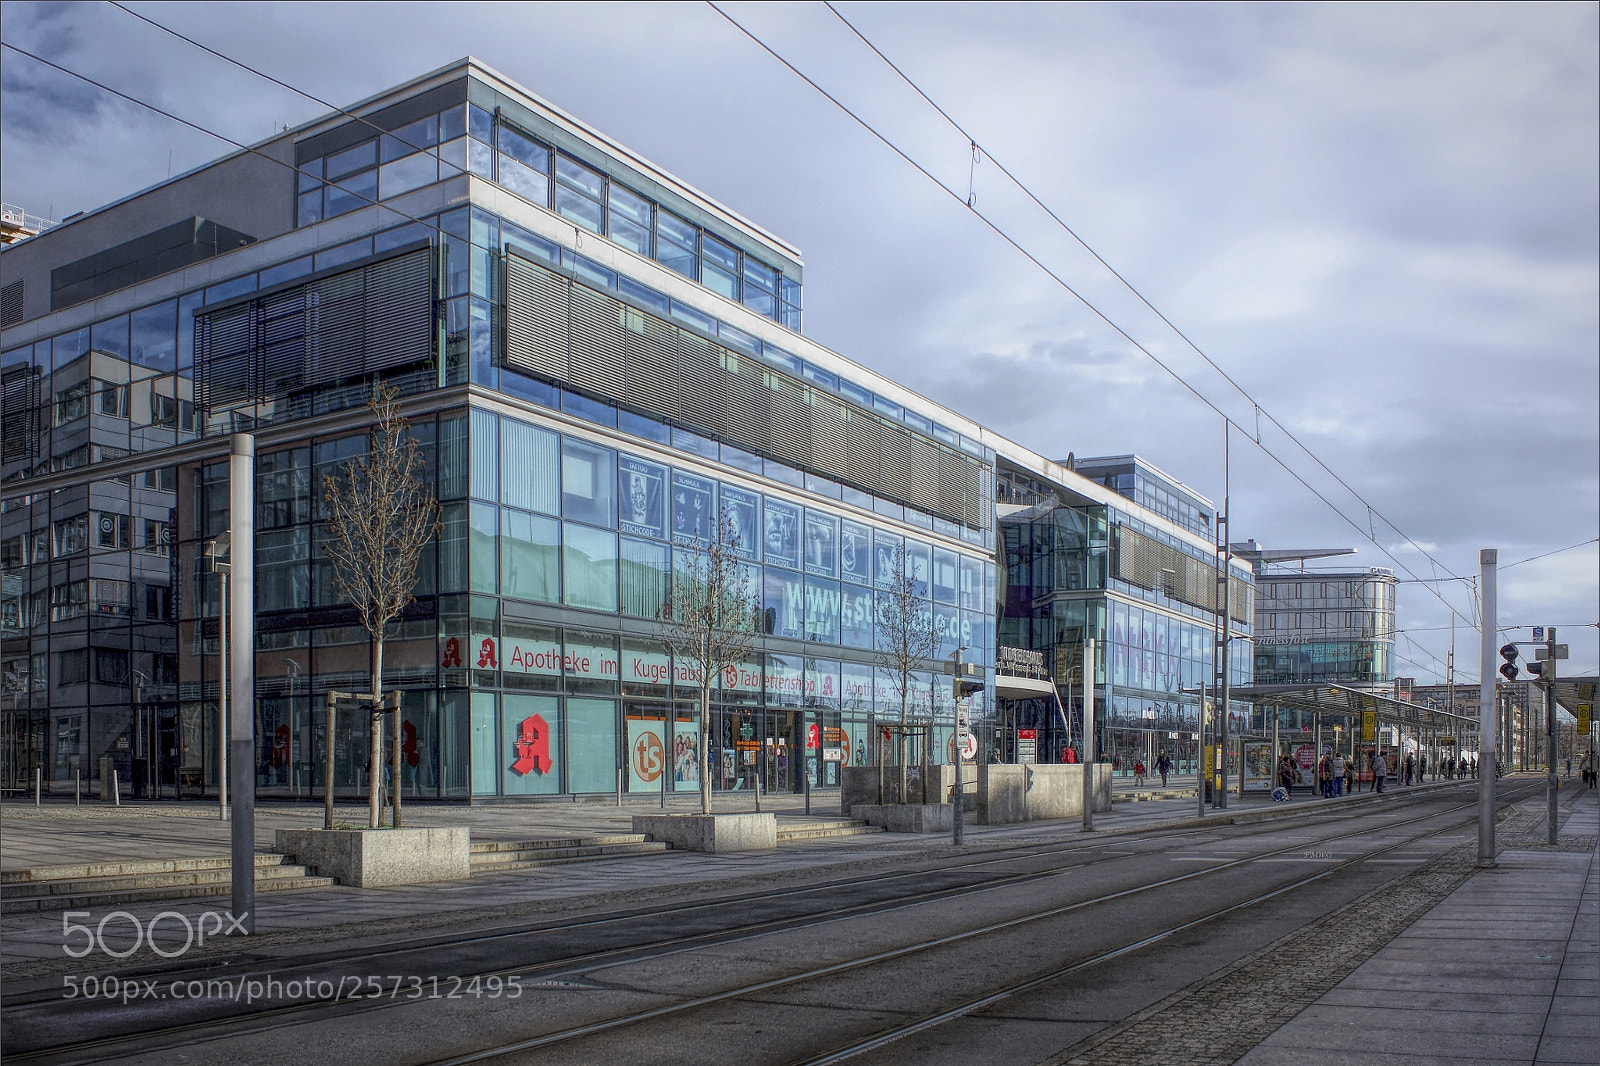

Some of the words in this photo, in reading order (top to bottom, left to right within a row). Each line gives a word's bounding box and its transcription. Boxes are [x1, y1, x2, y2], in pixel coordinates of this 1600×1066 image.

[510, 645, 591, 673] Apotheke
[600, 653, 618, 675] im
[739, 669, 816, 696] Tablettenshop
